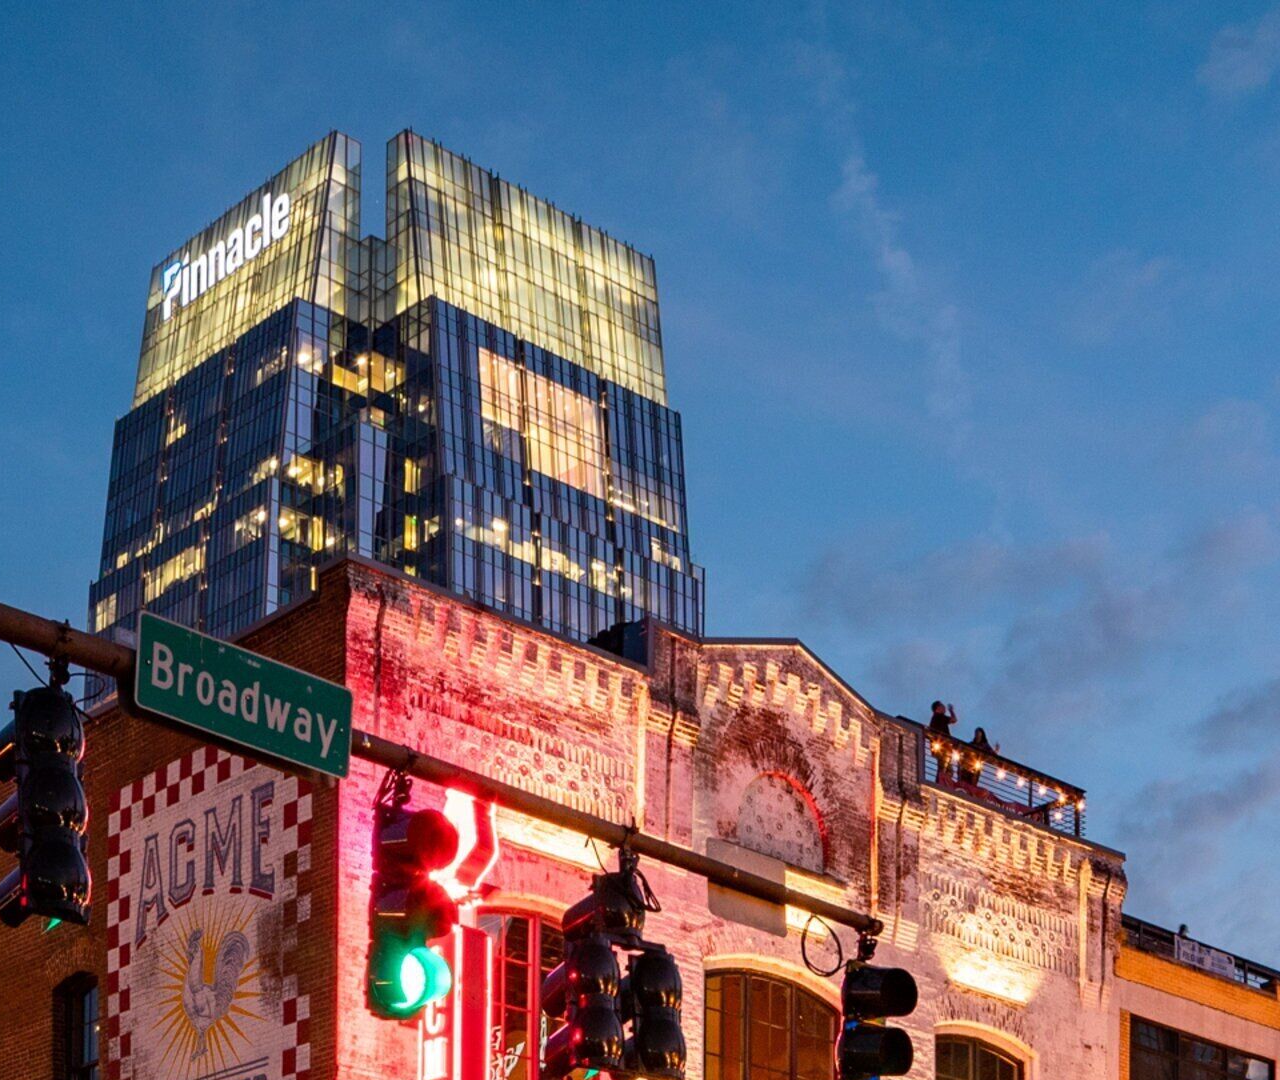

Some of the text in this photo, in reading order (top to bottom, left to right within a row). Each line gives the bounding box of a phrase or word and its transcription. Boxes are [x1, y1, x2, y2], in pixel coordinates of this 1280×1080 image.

[163, 192, 290, 320] Pinnacle
[151, 641, 338, 759] Broadway
[135, 780, 276, 950] ACME
